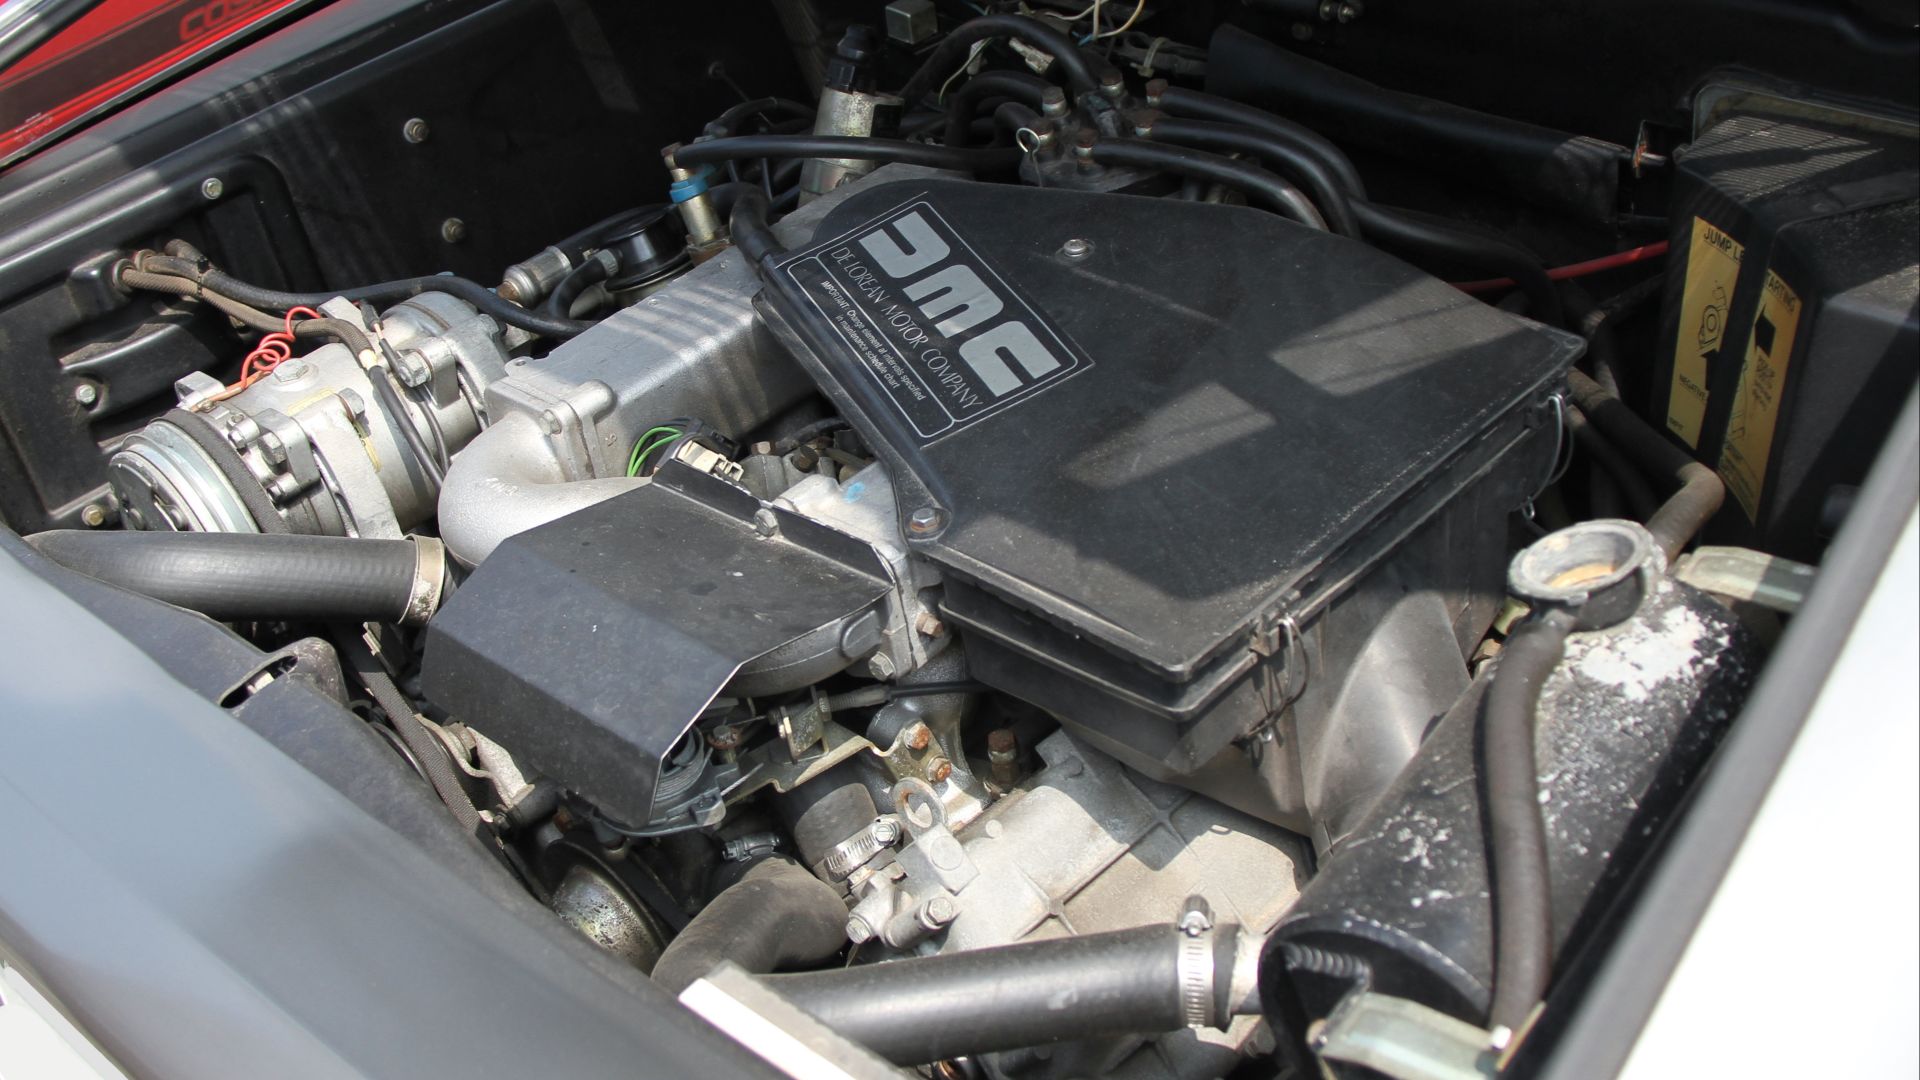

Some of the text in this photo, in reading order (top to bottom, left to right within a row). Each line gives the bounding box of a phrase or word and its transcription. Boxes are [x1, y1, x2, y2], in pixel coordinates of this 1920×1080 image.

[1704, 227, 1732, 252] JUMP
[821, 281, 850, 309] IMPORTANT
[847, 310, 865, 329] Change
[862, 329, 883, 349] element
[883, 353, 904, 376] intervals
[901, 375, 927, 401] specified
[831, 247, 983, 409] DE LOREAN MOTOR COMPANY
[840, 320, 869, 351] maintenance
[865, 351, 887, 374] schedule
[884, 373, 900, 389] chart
